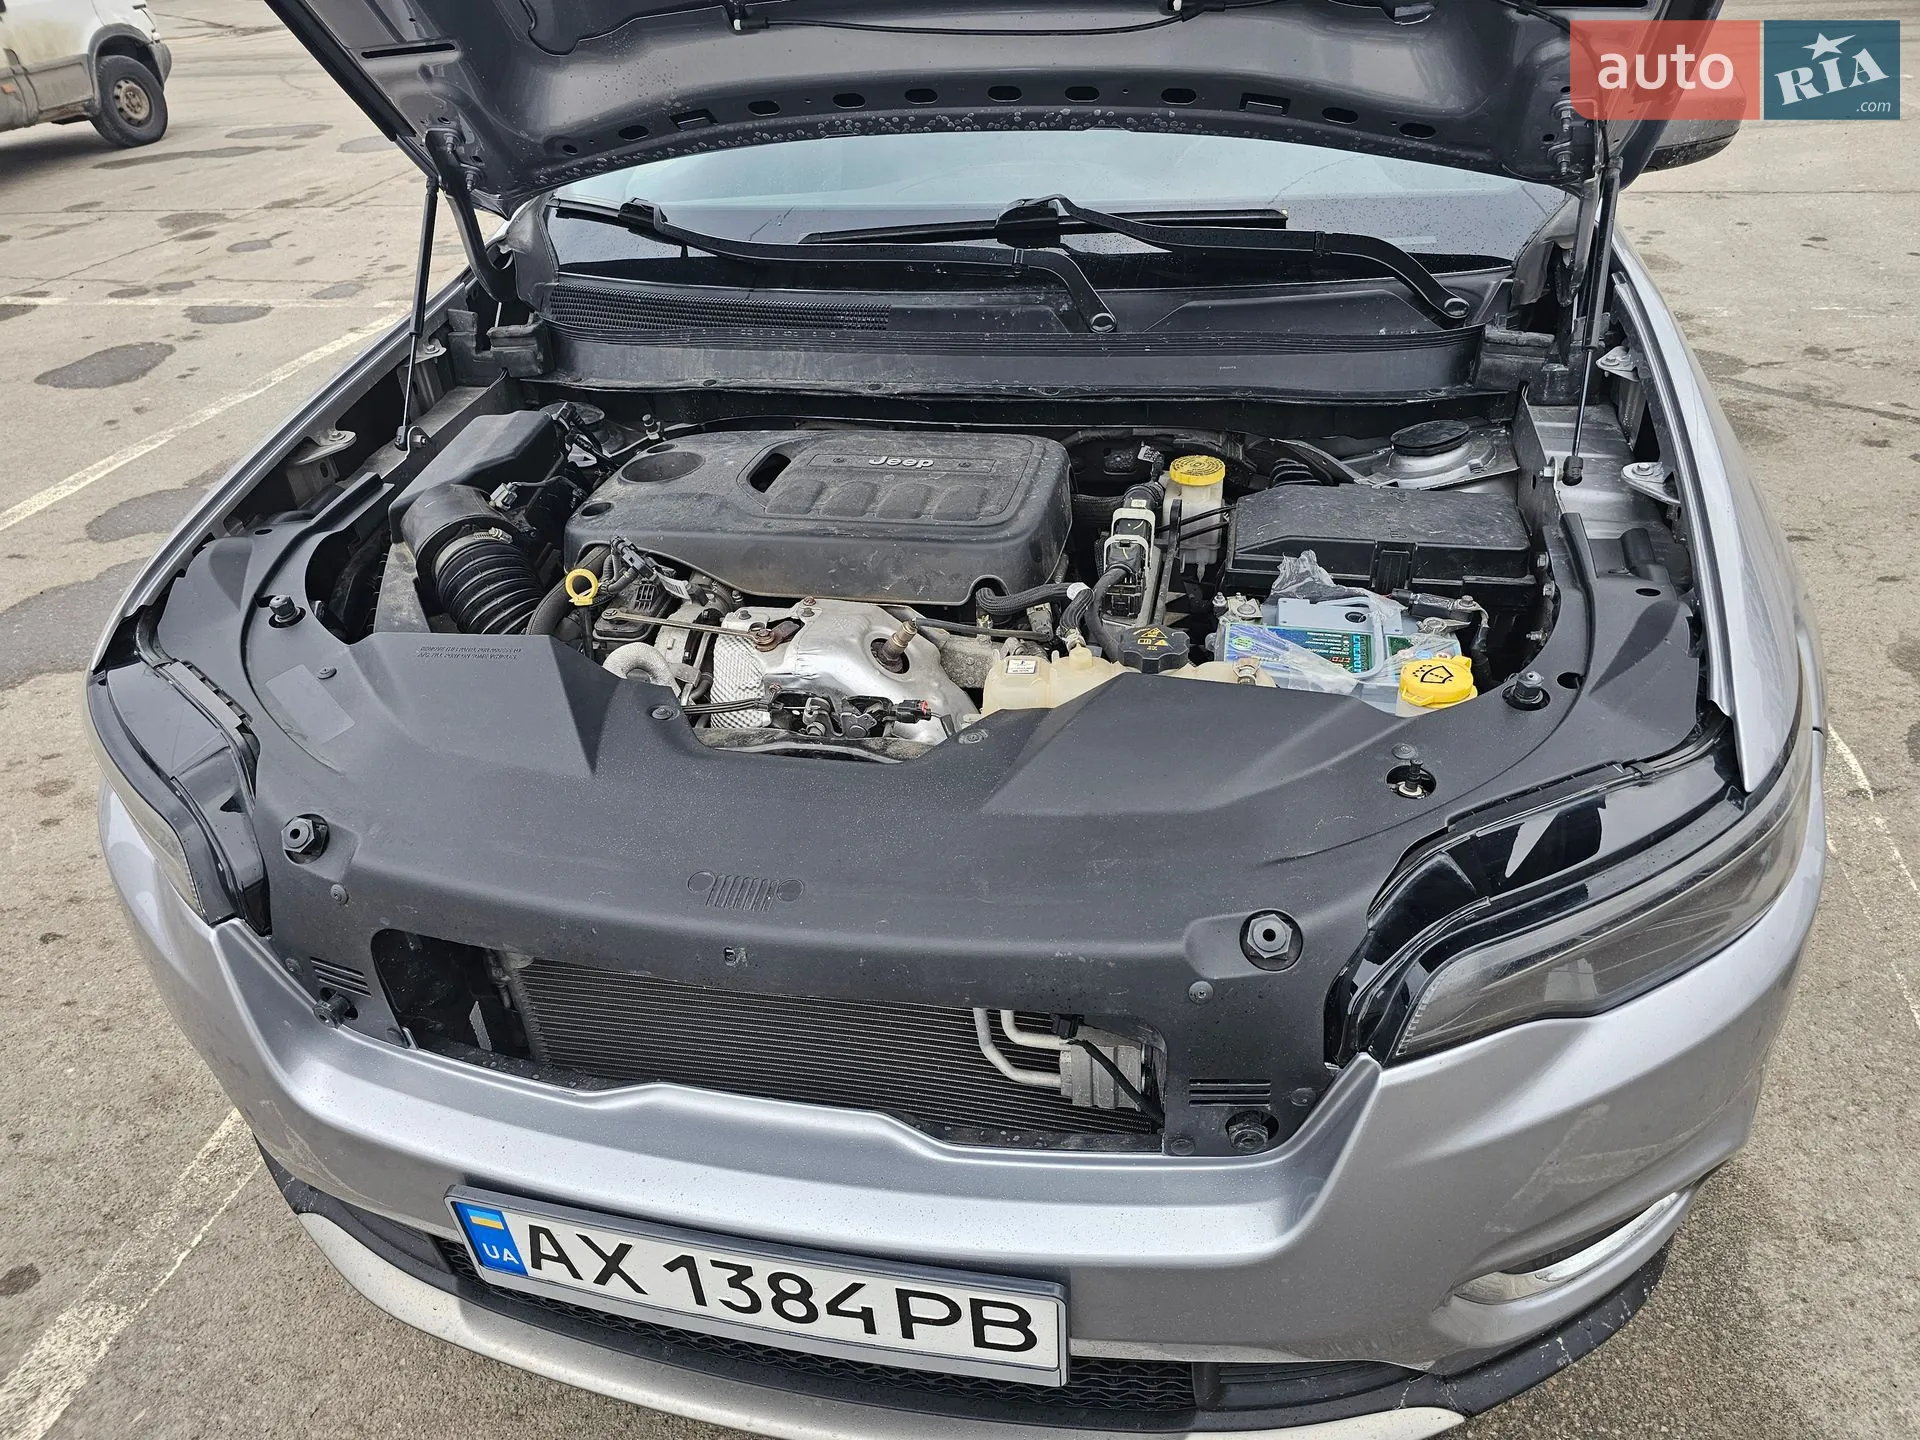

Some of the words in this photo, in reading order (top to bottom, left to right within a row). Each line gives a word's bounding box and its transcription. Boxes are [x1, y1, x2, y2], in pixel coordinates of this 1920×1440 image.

[868, 455, 934, 470] Jeep
[482, 1242, 519, 1265] UA
[529, 1225, 648, 1295] AX
[662, 1254, 877, 1335] 1384
[896, 1288, 1038, 1353] PB
